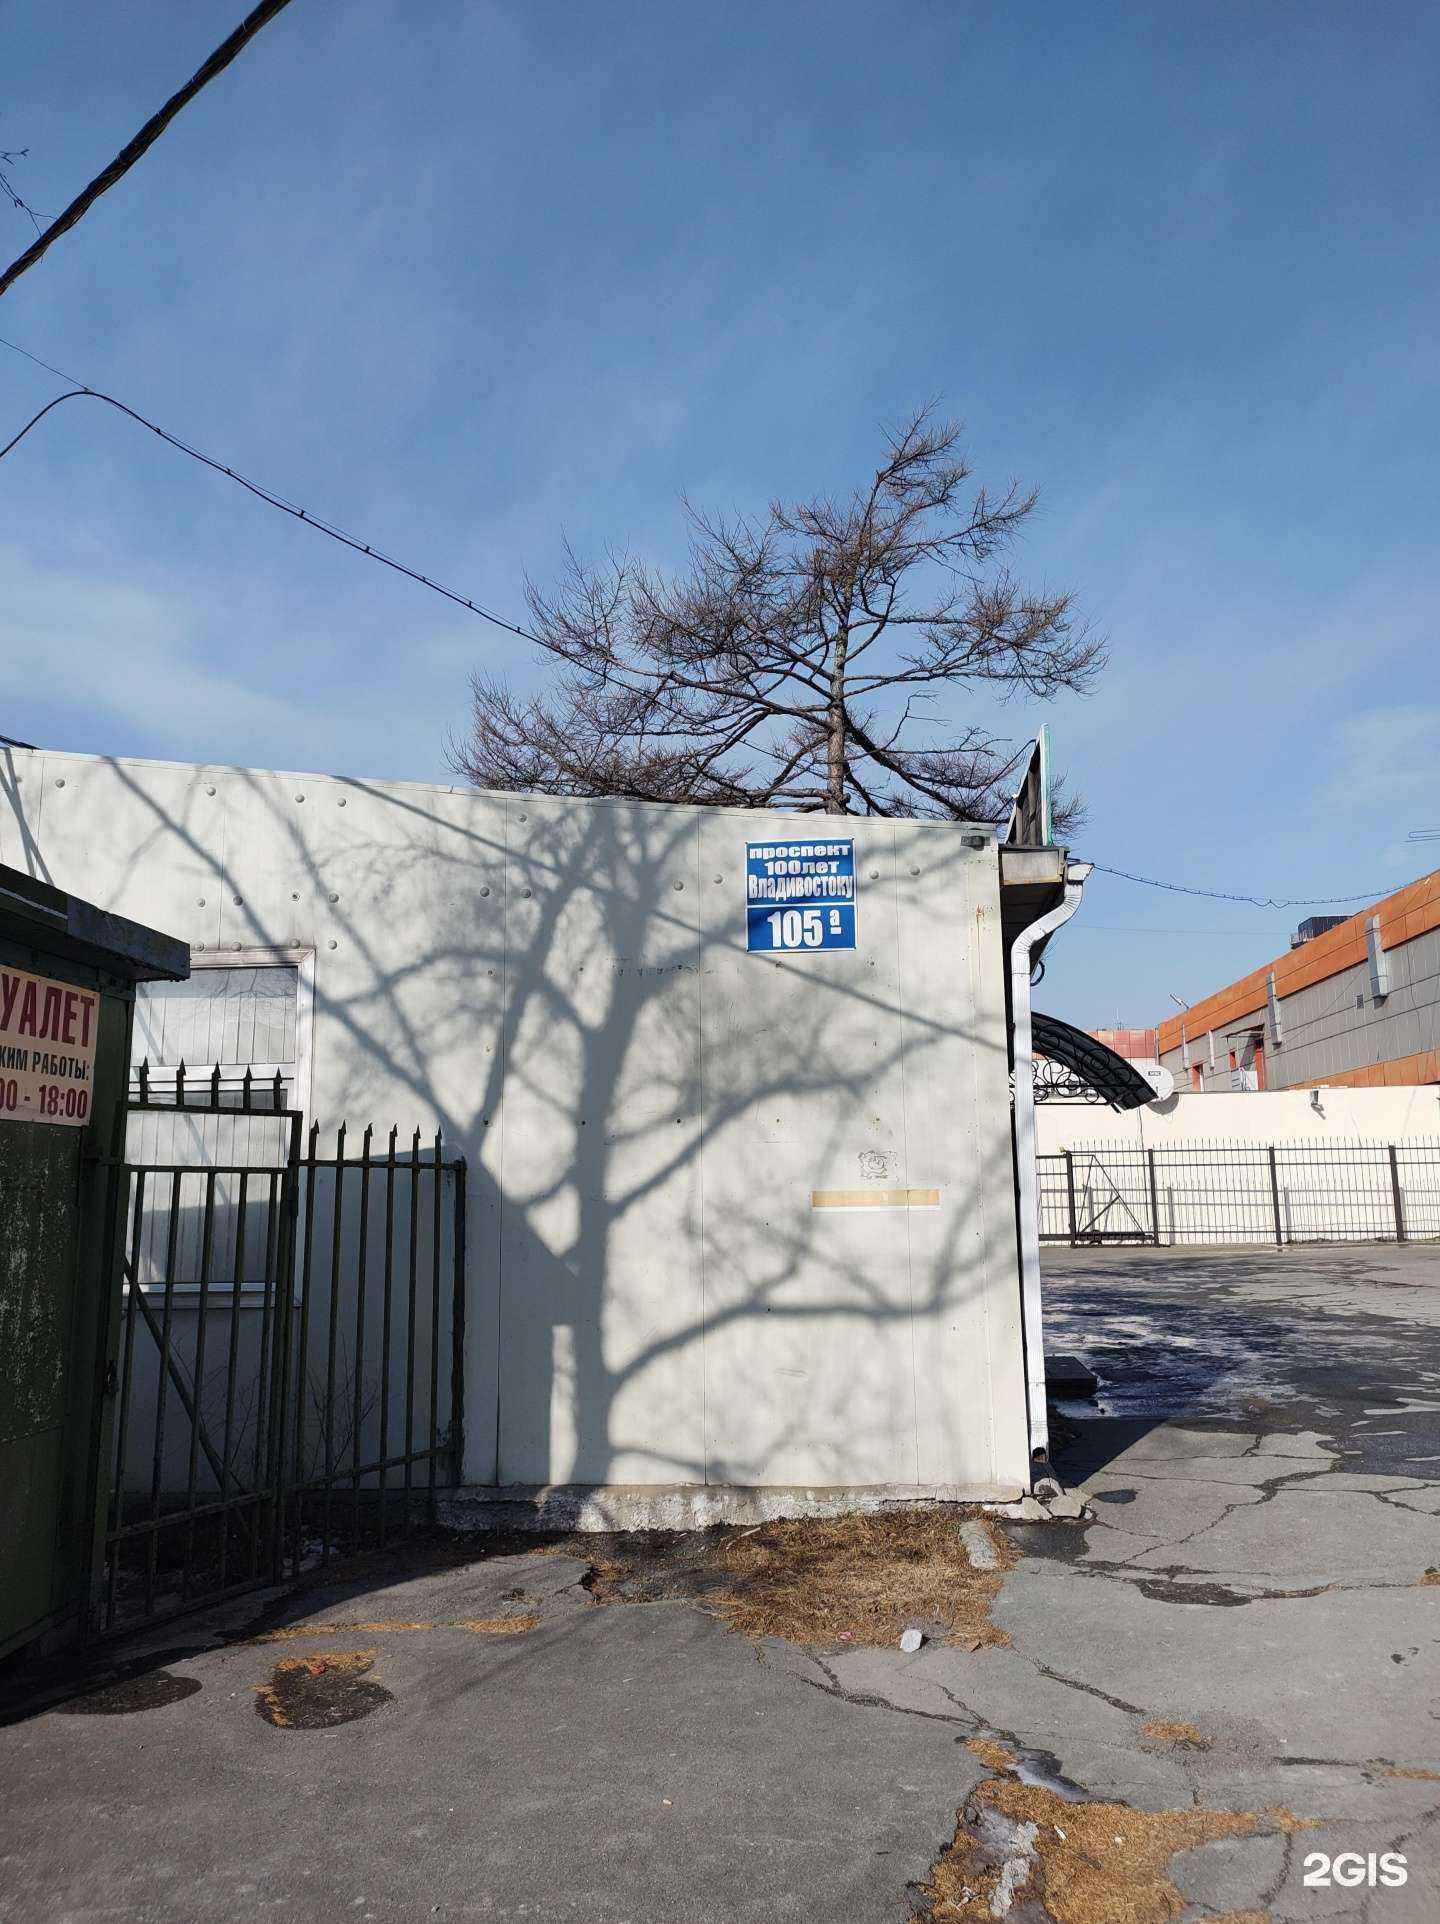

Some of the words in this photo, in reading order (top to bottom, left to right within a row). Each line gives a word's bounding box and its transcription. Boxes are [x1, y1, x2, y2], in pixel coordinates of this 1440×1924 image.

[749, 844, 851, 860] проспект
[748, 874, 854, 901] Владивостоку
[767, 909, 824, 948] 105
[32, 1051, 90, 1081] РАБОТЫ:
[39, 1084, 88, 1119] 18:00
